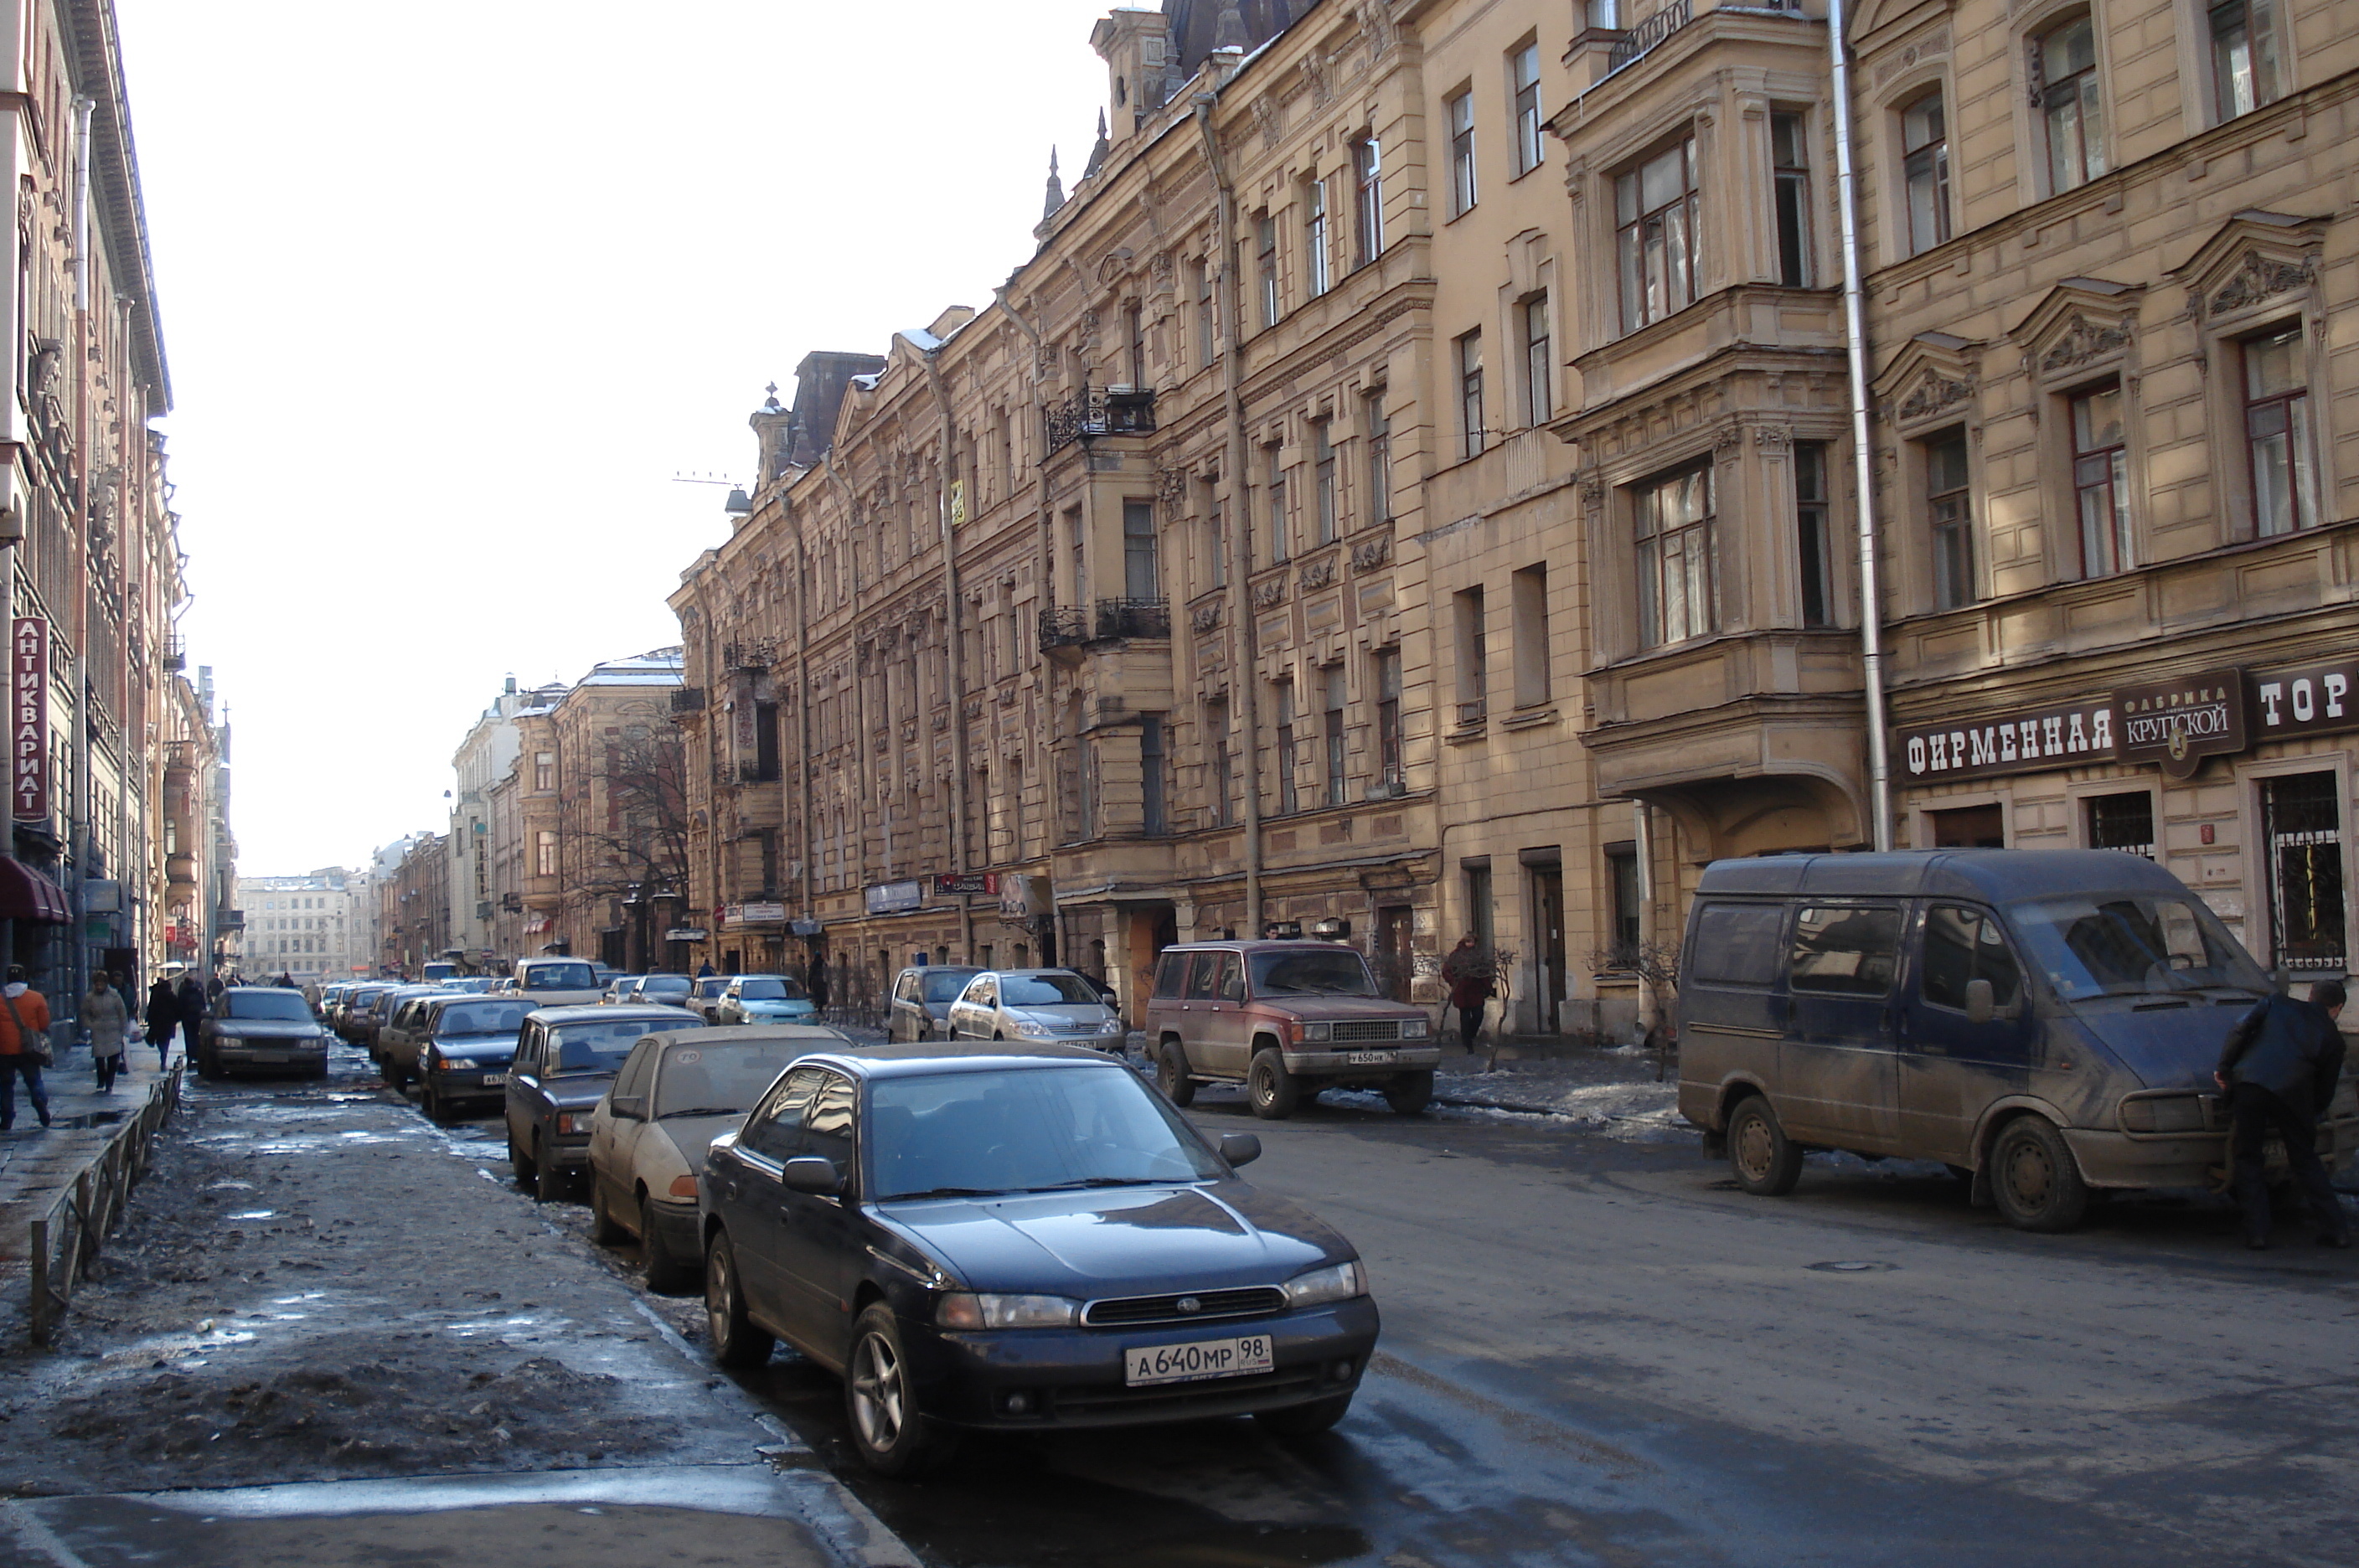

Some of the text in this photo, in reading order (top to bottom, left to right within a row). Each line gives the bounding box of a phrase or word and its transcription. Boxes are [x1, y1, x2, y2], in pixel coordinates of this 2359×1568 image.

[18, 622, 39, 809] АНТИКВАРИАТ
[2124, 687, 2226, 713] ФАБРИКА
[1907, 670, 2359, 776] ФИРМЕННАЯ ТОР
[2126, 703, 2229, 745] КРУПСКОЙ
[680, 1053, 697, 1061] 70
[1138, 1338, 1264, 1377] А640МР 98
